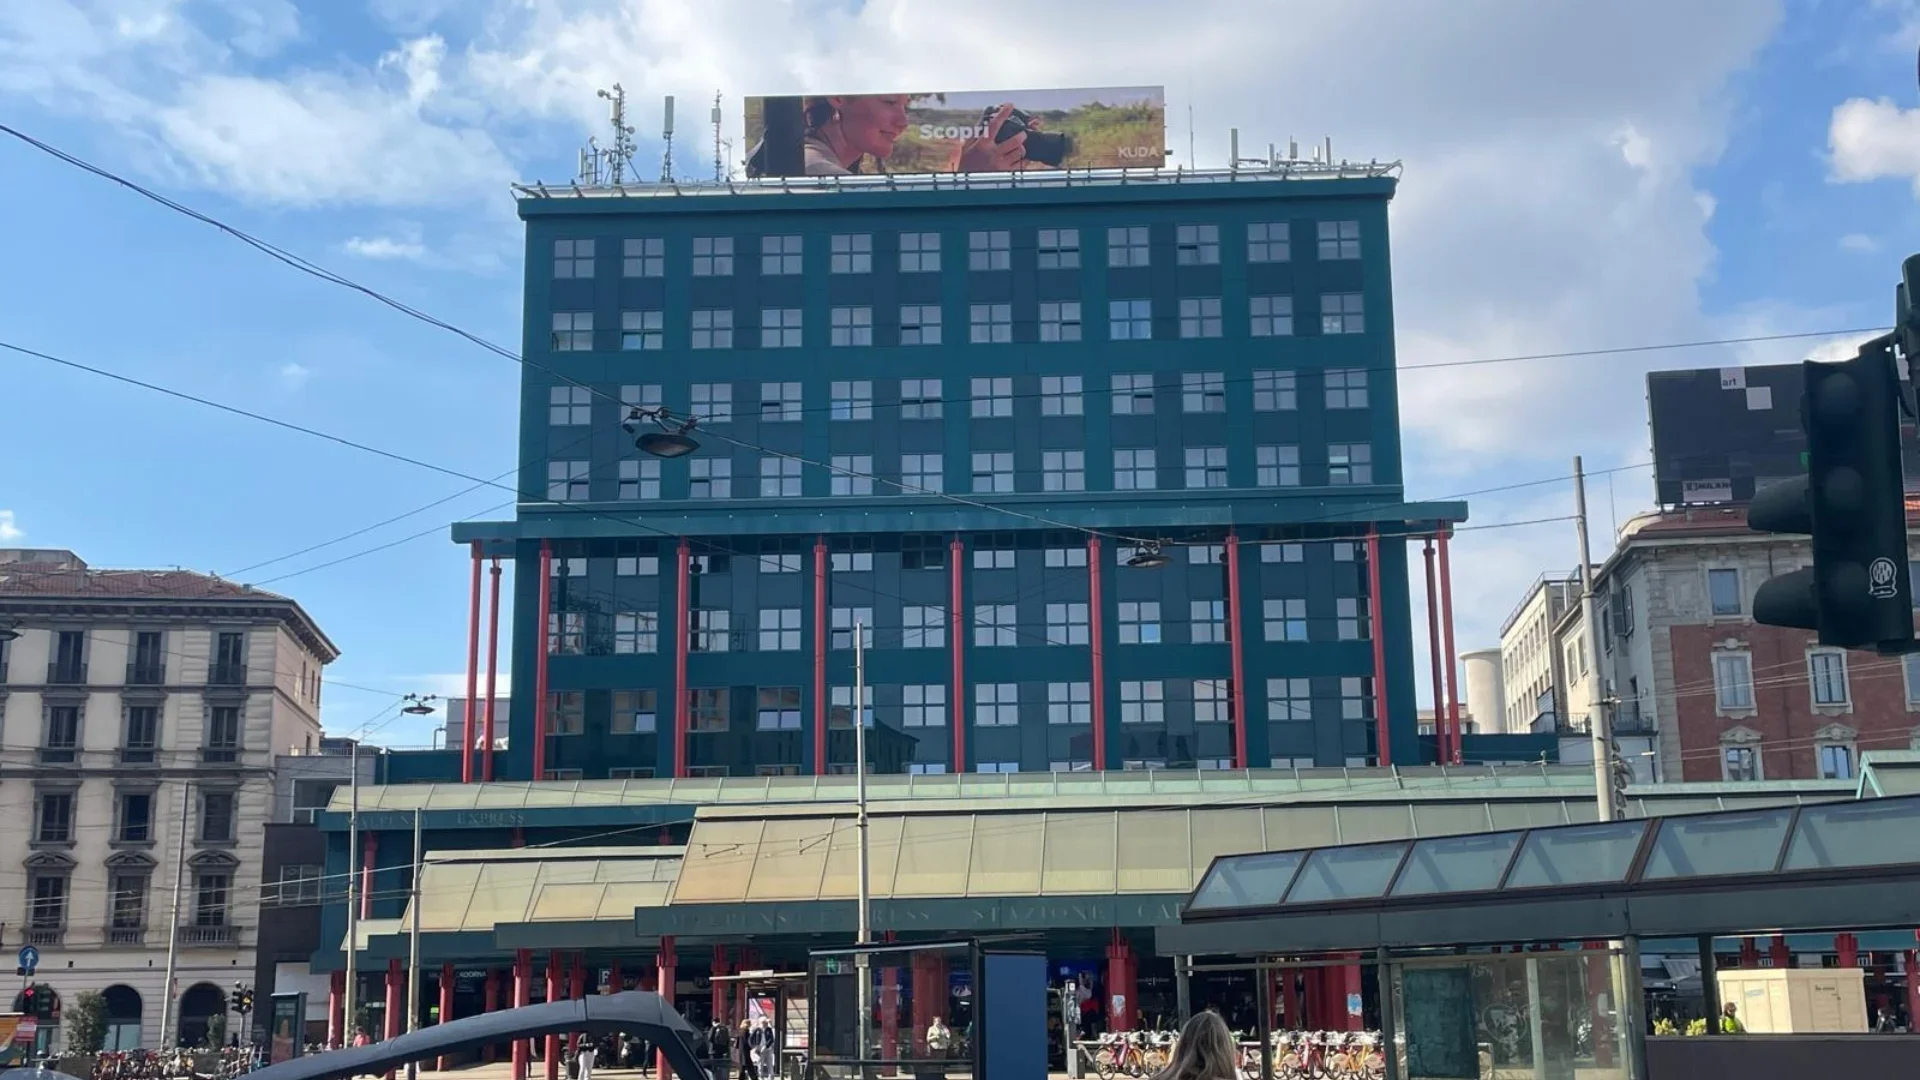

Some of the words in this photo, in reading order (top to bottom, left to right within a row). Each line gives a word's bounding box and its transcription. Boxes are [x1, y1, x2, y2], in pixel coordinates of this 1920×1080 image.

[919, 120, 990, 142] Scopri
[1117, 146, 1160, 158] KUDA
[1722, 377, 1737, 387] art
[819, 906, 930, 925] EXRESS
[972, 903, 1106, 922] STAZIONE
